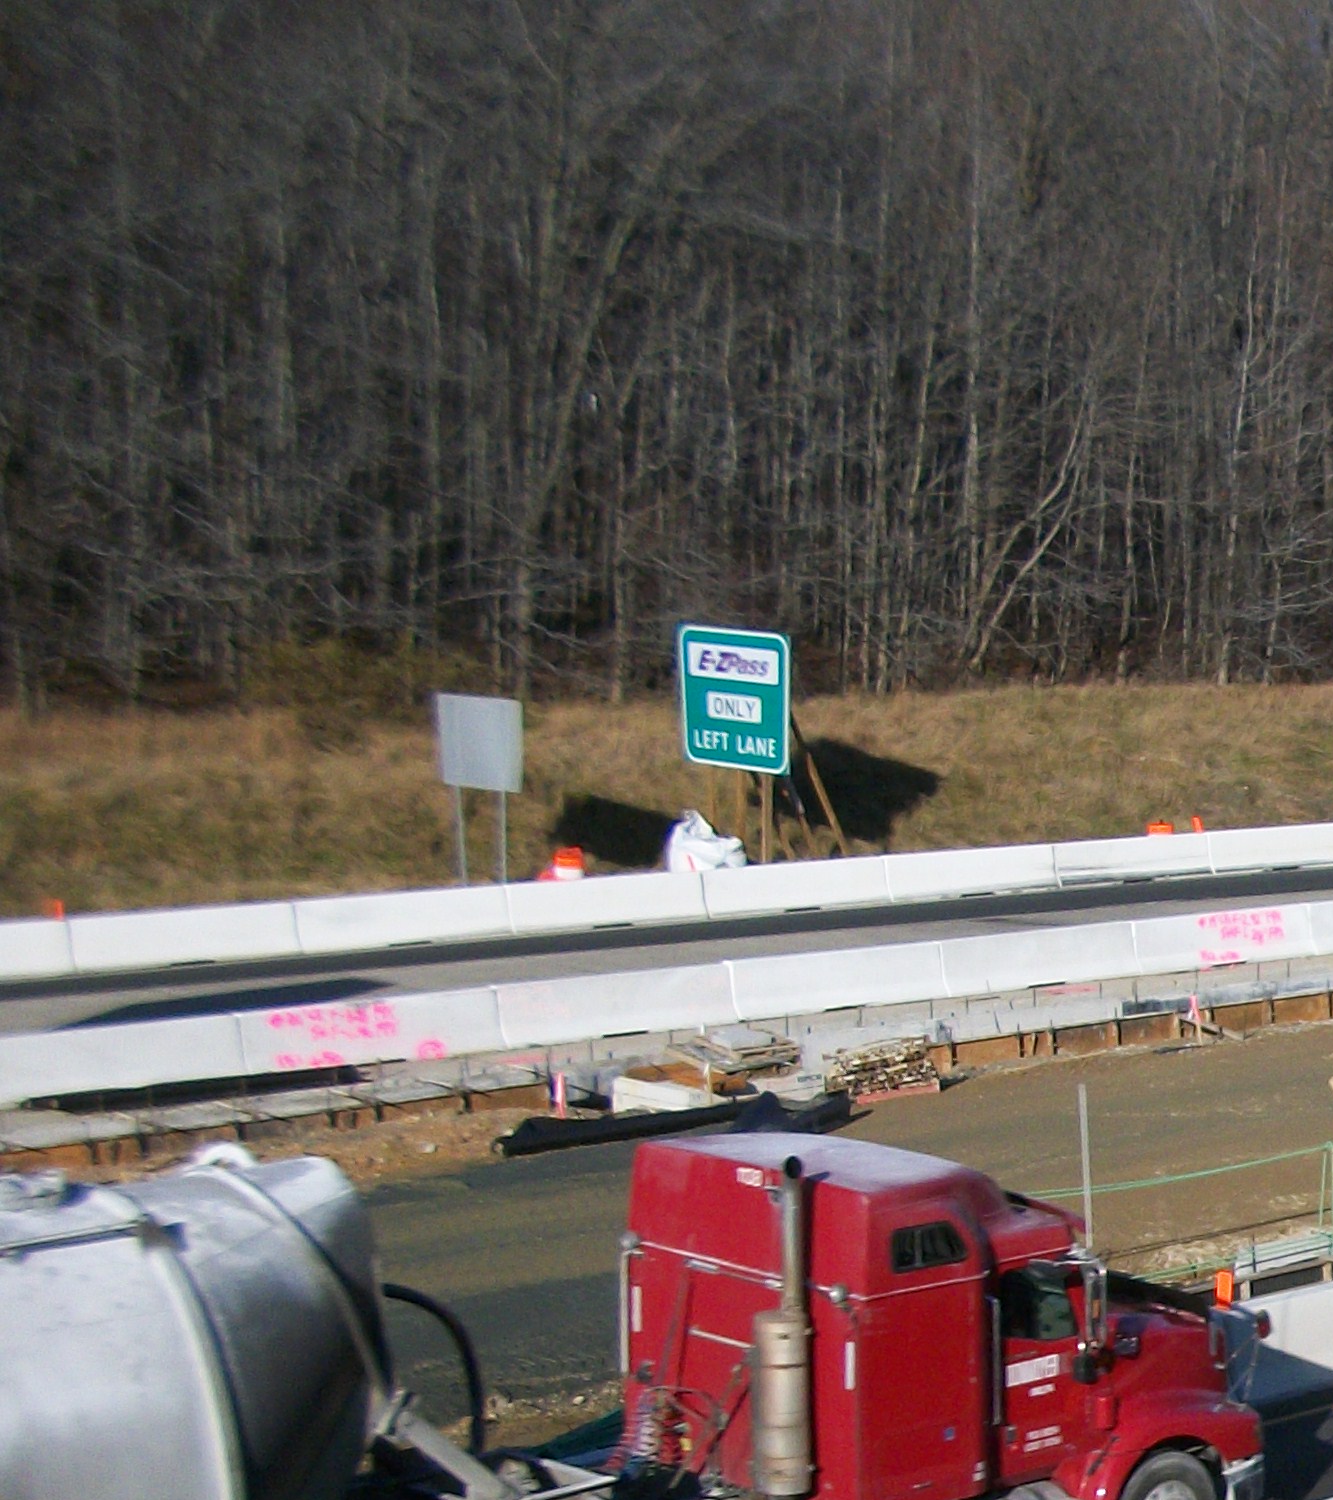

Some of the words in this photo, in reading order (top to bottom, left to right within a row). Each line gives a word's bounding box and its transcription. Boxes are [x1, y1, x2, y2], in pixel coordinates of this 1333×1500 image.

[698, 650, 770, 677] E-ZPass
[713, 697, 756, 719] ONLY
[693, 729, 729, 751] LEFT
[736, 734, 777, 758] LANE
